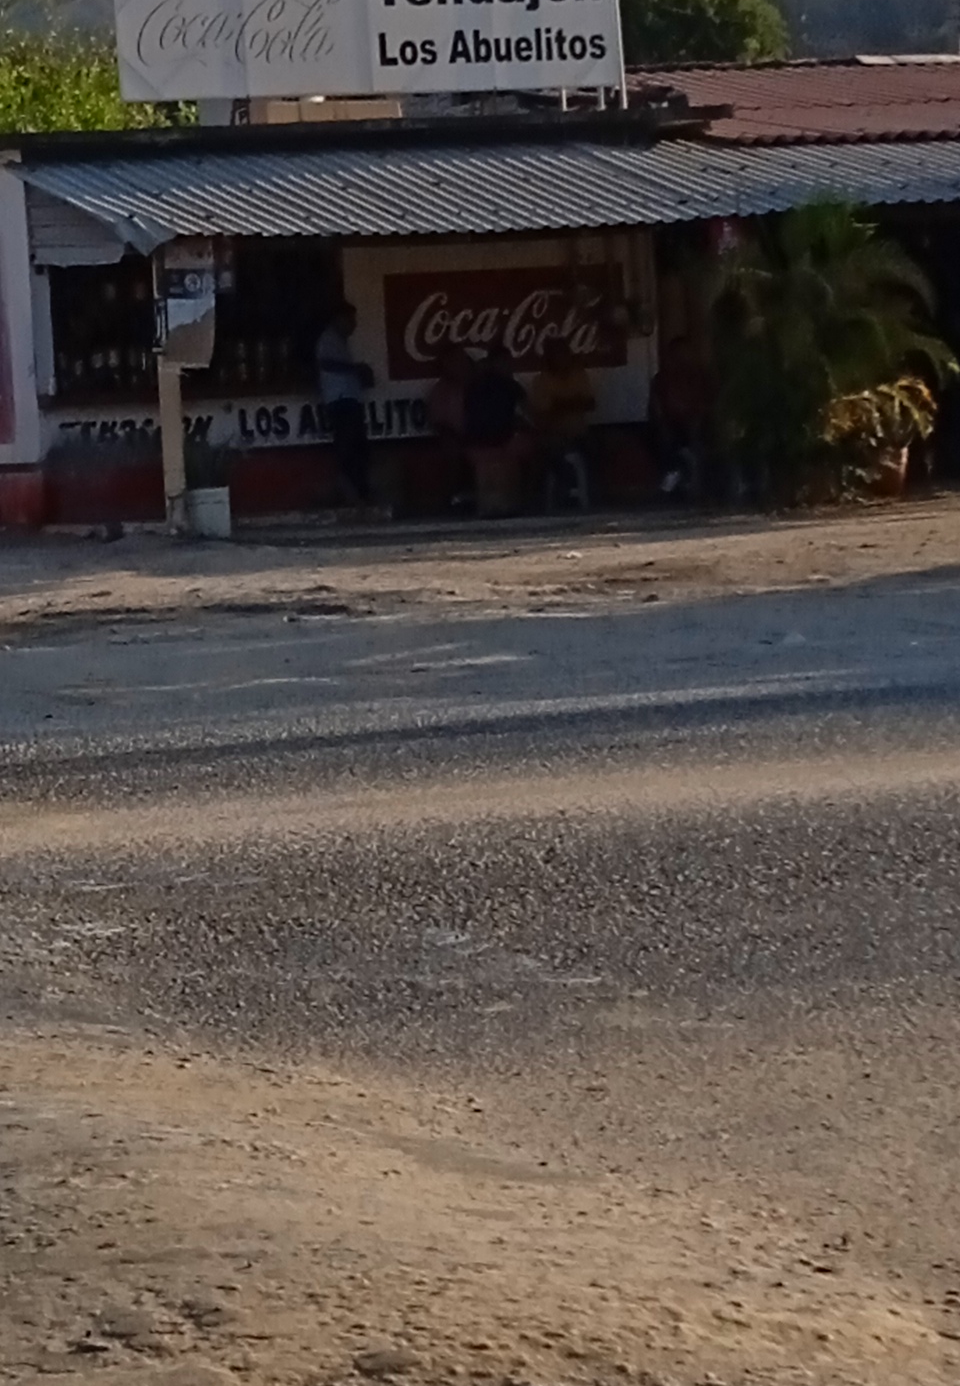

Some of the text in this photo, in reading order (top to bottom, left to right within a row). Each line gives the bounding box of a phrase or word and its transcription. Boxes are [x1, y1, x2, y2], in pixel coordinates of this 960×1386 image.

[378, 26, 607, 67] Los Abuelitos
[239, 405, 291, 438] LOS
